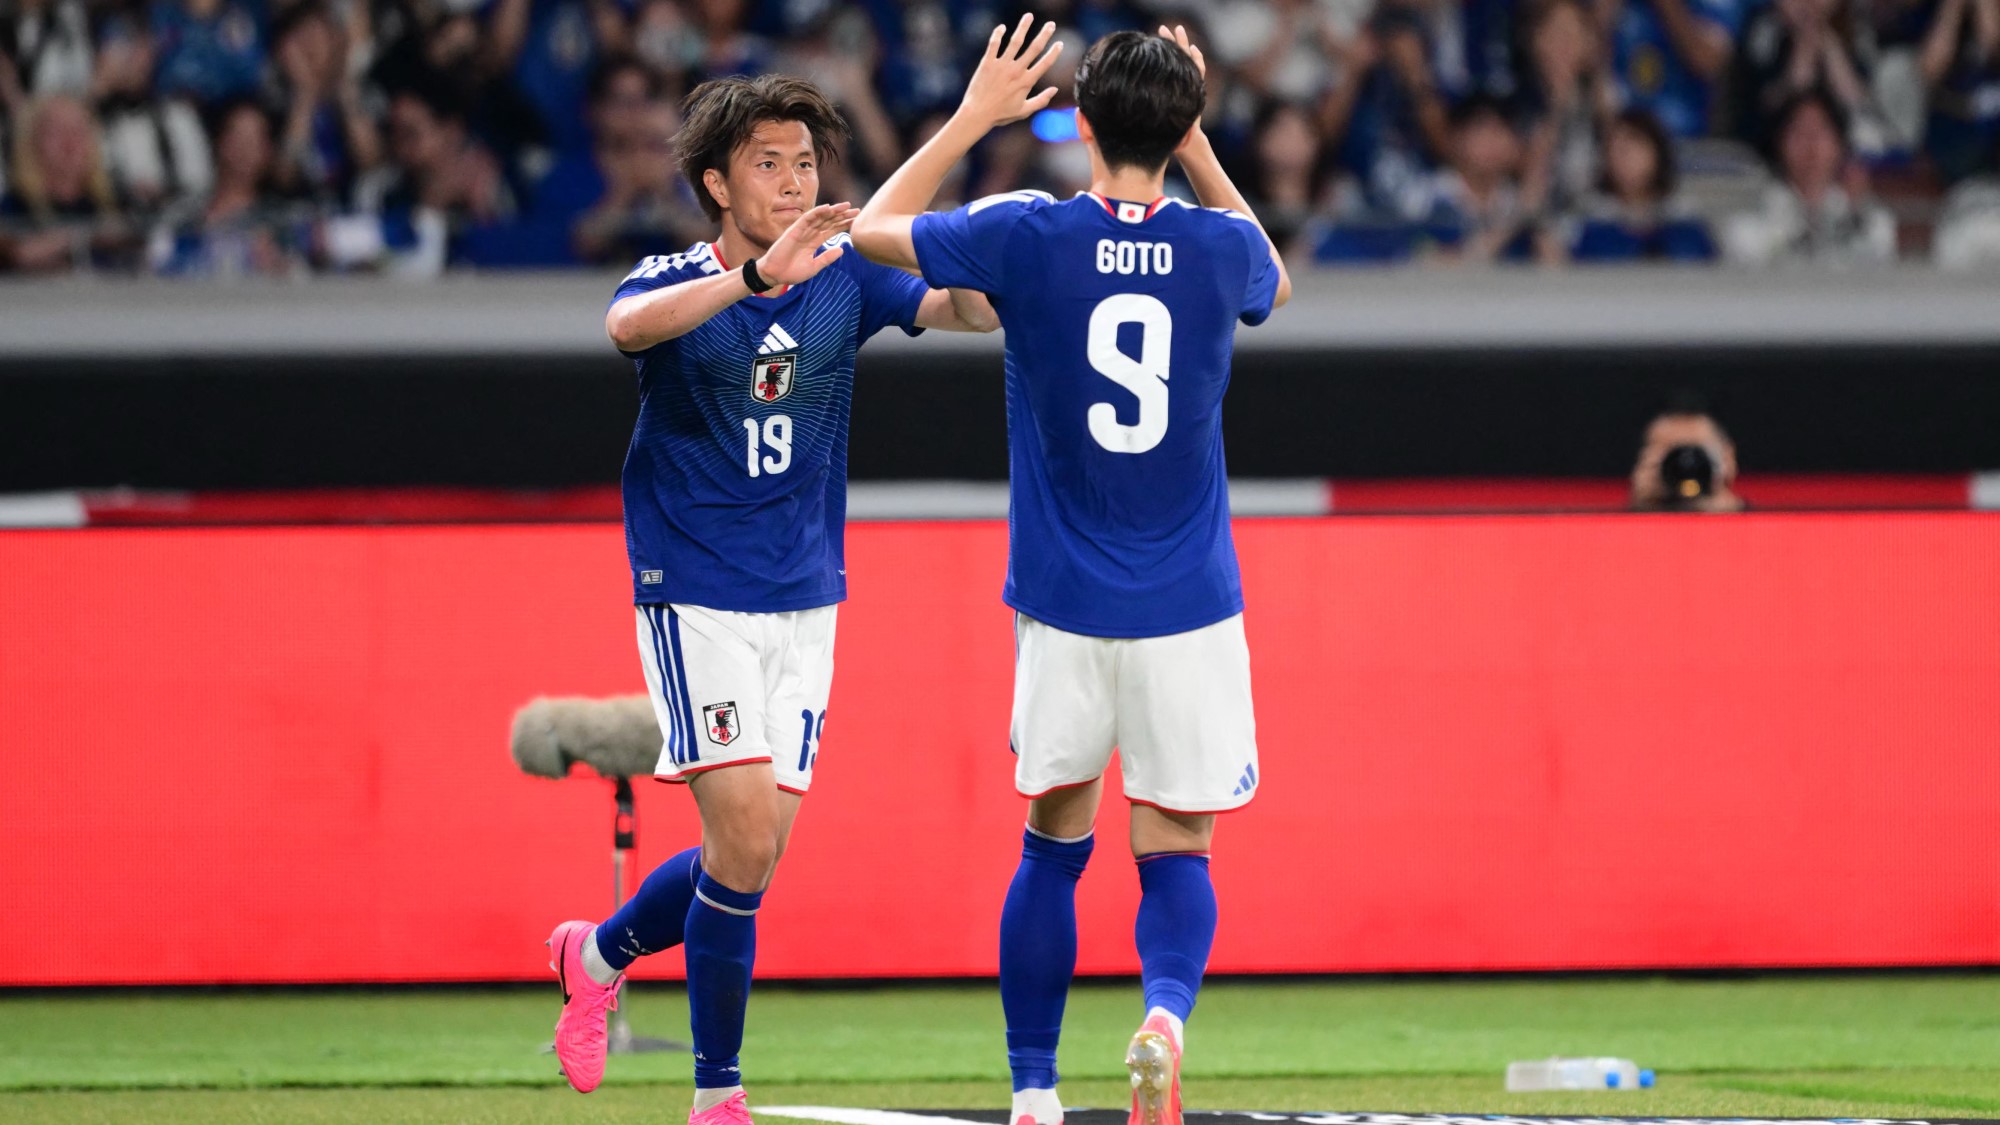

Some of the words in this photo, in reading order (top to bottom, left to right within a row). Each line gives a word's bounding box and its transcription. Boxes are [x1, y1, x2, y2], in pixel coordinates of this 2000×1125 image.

[1096, 239, 1173, 275] GOTO
[1087, 293, 1172, 453] 9
[761, 388, 780, 398] JFA
[743, 414, 793, 478] 19
[710, 702, 729, 710] JAPAN
[717, 731, 733, 741] JFA
